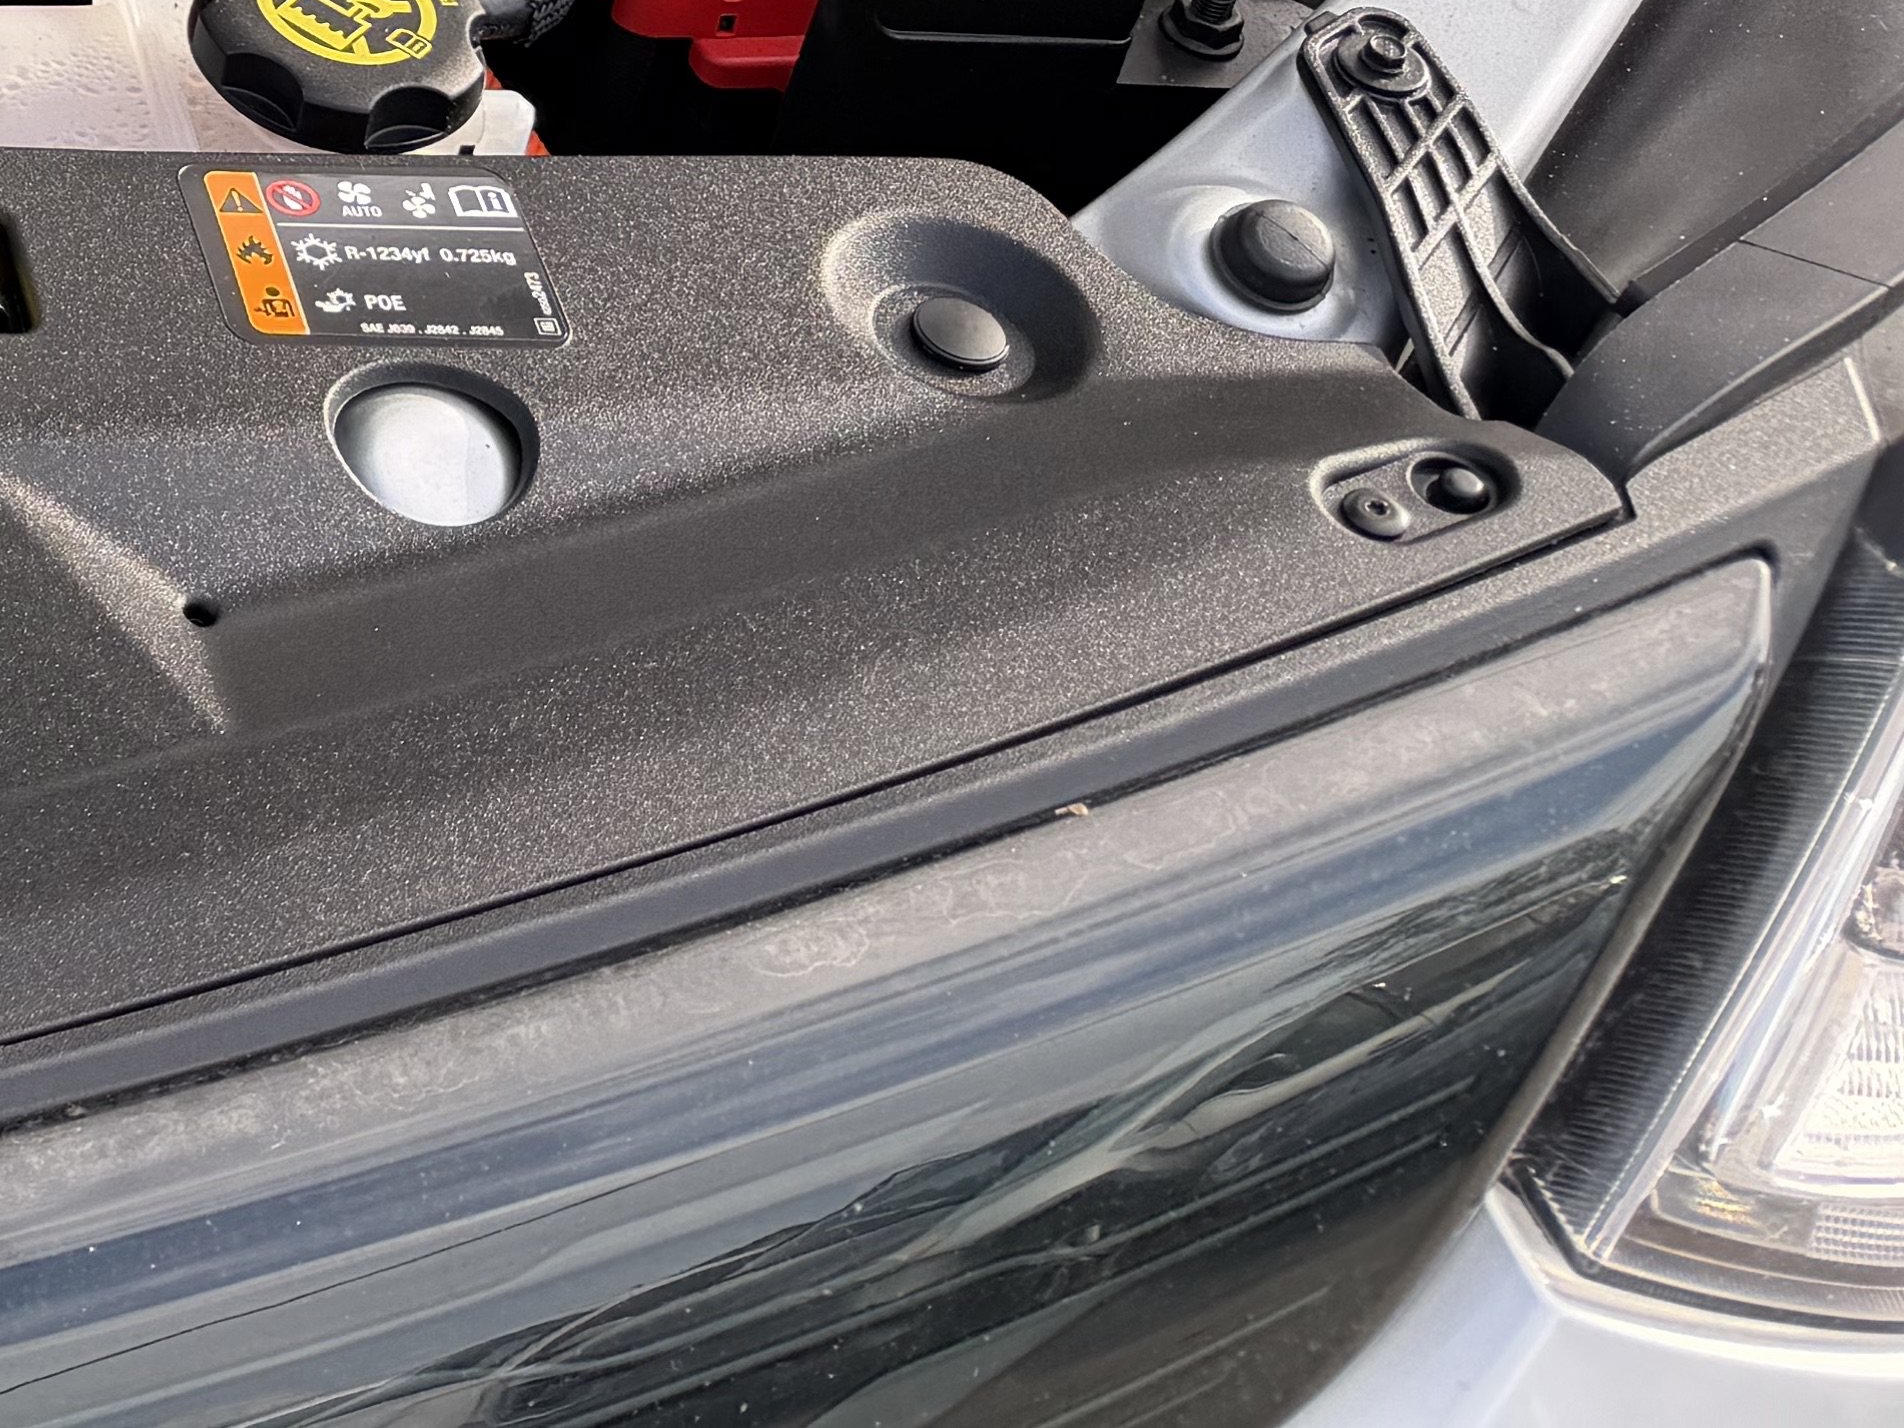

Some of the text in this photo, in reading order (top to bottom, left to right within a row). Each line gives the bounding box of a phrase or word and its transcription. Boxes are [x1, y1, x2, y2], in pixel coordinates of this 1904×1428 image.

[342, 205, 382, 218] AUTO
[344, 246, 516, 266] R-1234yf 0.725kg
[364, 295, 407, 312] POE
[360, 322, 384, 333] SAE
[425, 324, 459, 335] J2842
[469, 325, 504, 336] J2845
